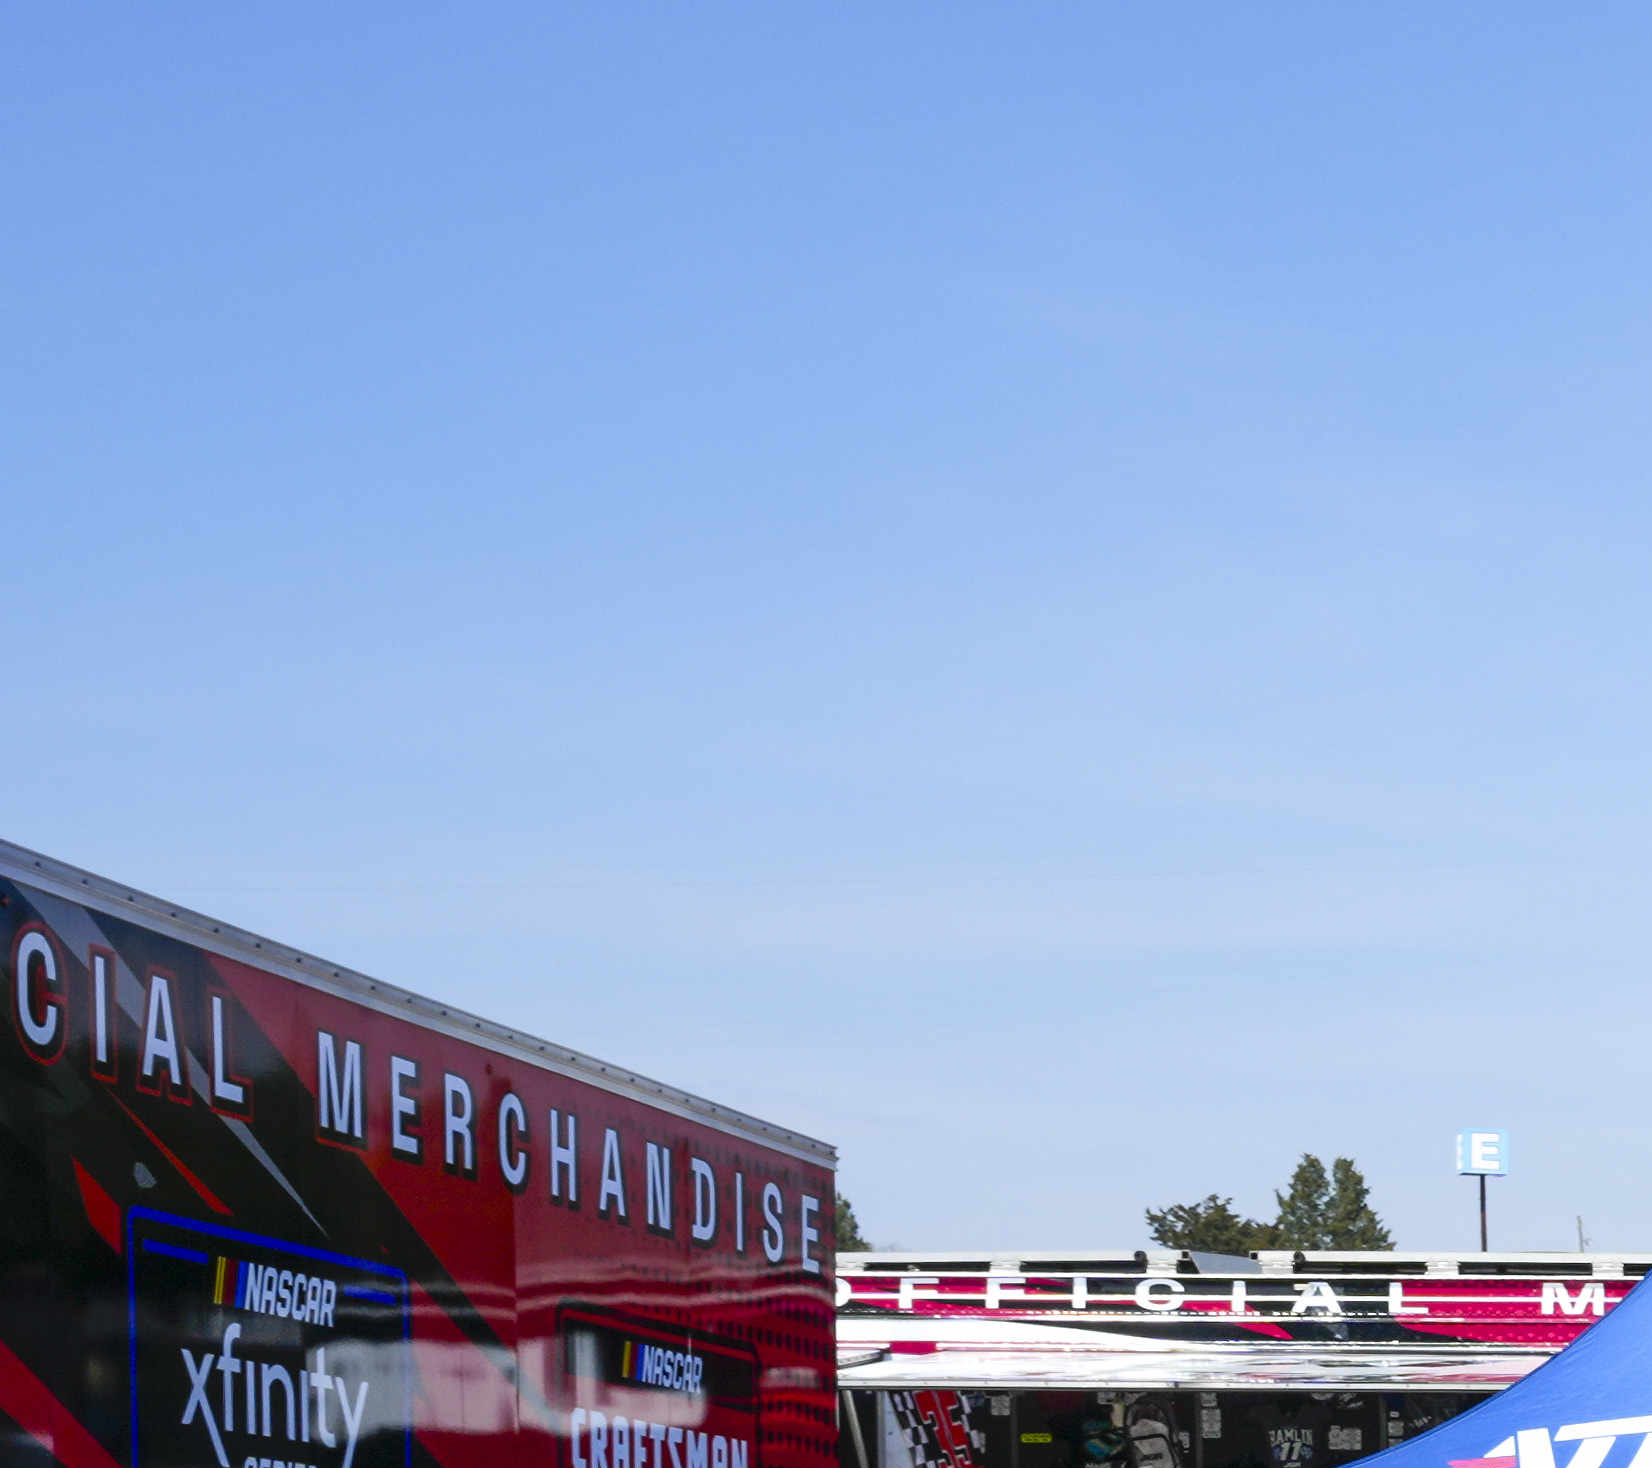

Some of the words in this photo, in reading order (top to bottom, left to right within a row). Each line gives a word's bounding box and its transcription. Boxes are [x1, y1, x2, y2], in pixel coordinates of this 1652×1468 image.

[317, 1030, 822, 1275] MERCHANDISE
[244, 1261, 337, 1328] NASCAR
[641, 1344, 704, 1393] NASCAR
